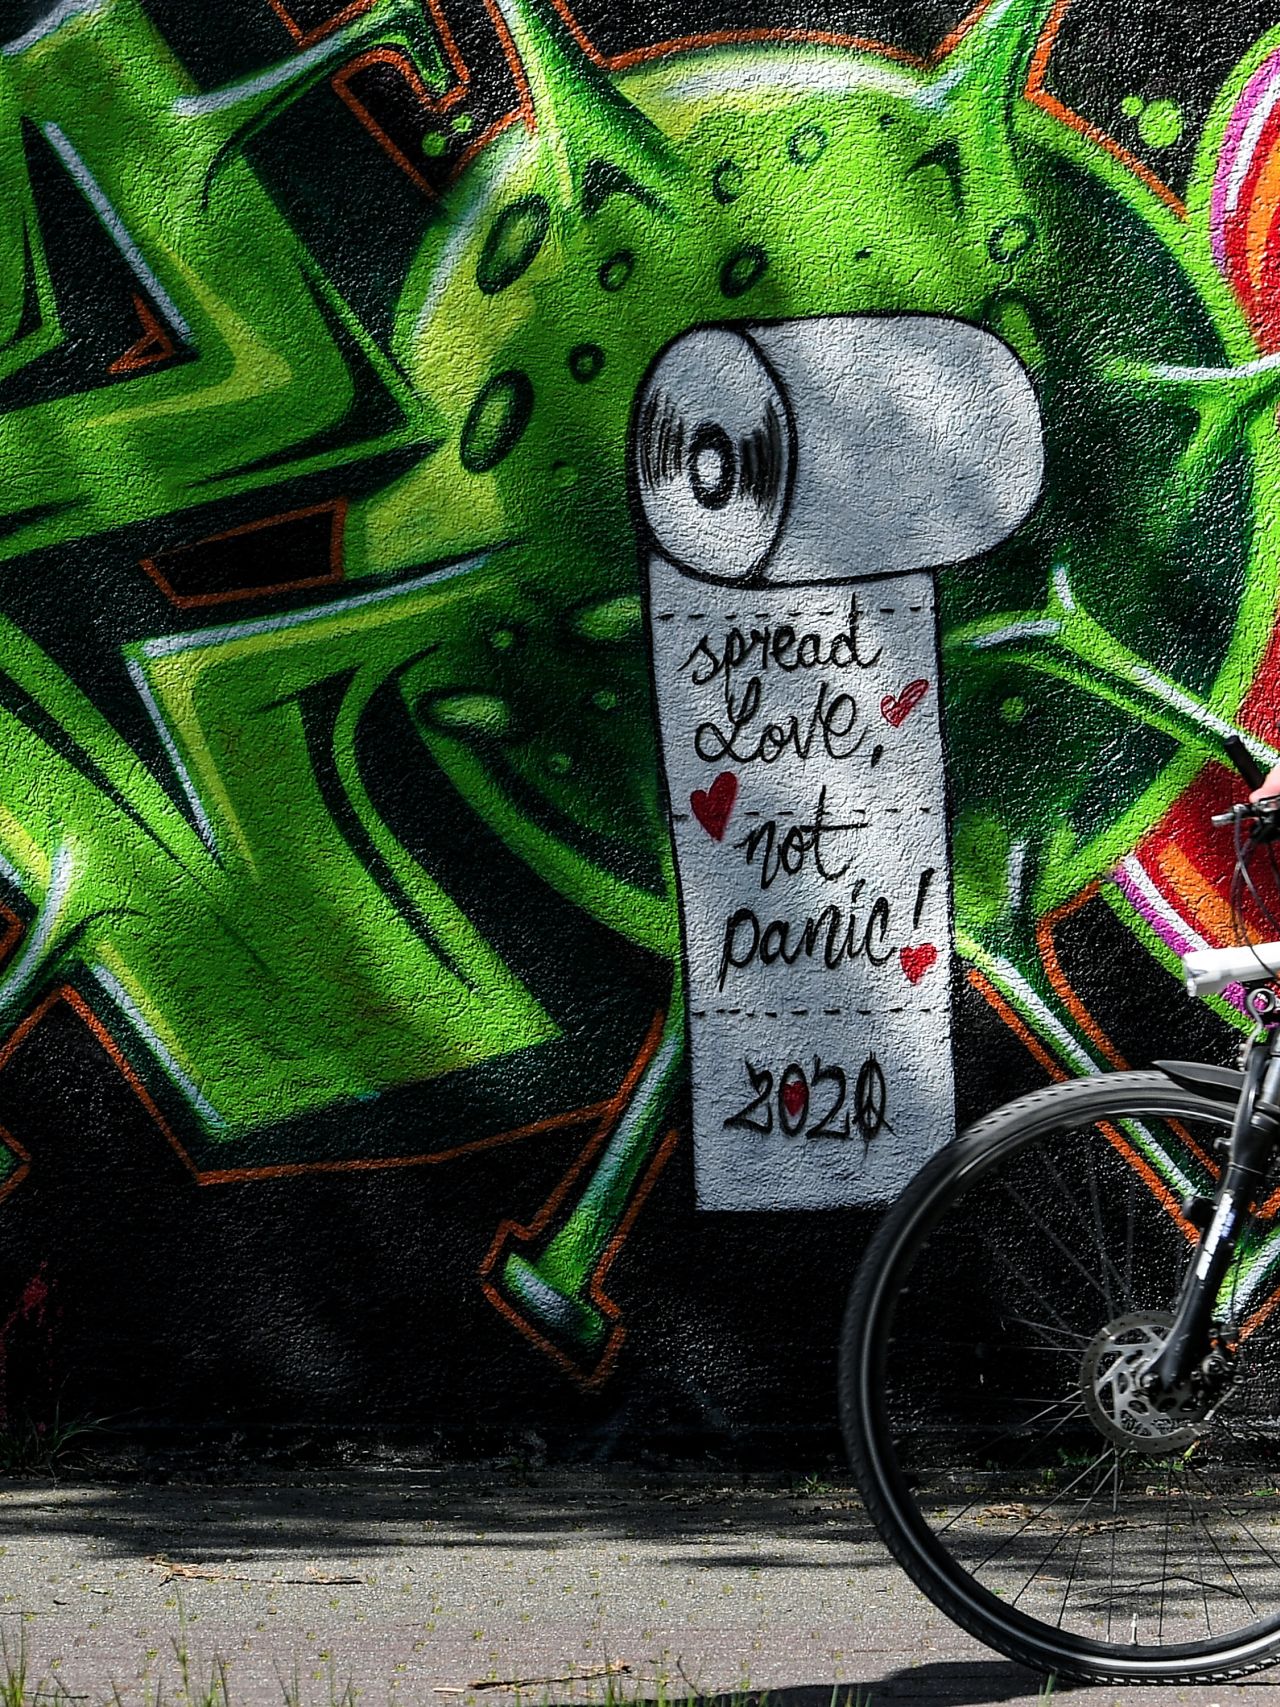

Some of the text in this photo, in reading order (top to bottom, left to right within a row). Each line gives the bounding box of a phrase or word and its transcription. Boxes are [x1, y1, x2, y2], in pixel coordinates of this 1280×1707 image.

[678, 592, 883, 702] spread
[734, 785, 869, 890] not
[723, 1053, 899, 1141] 2020
